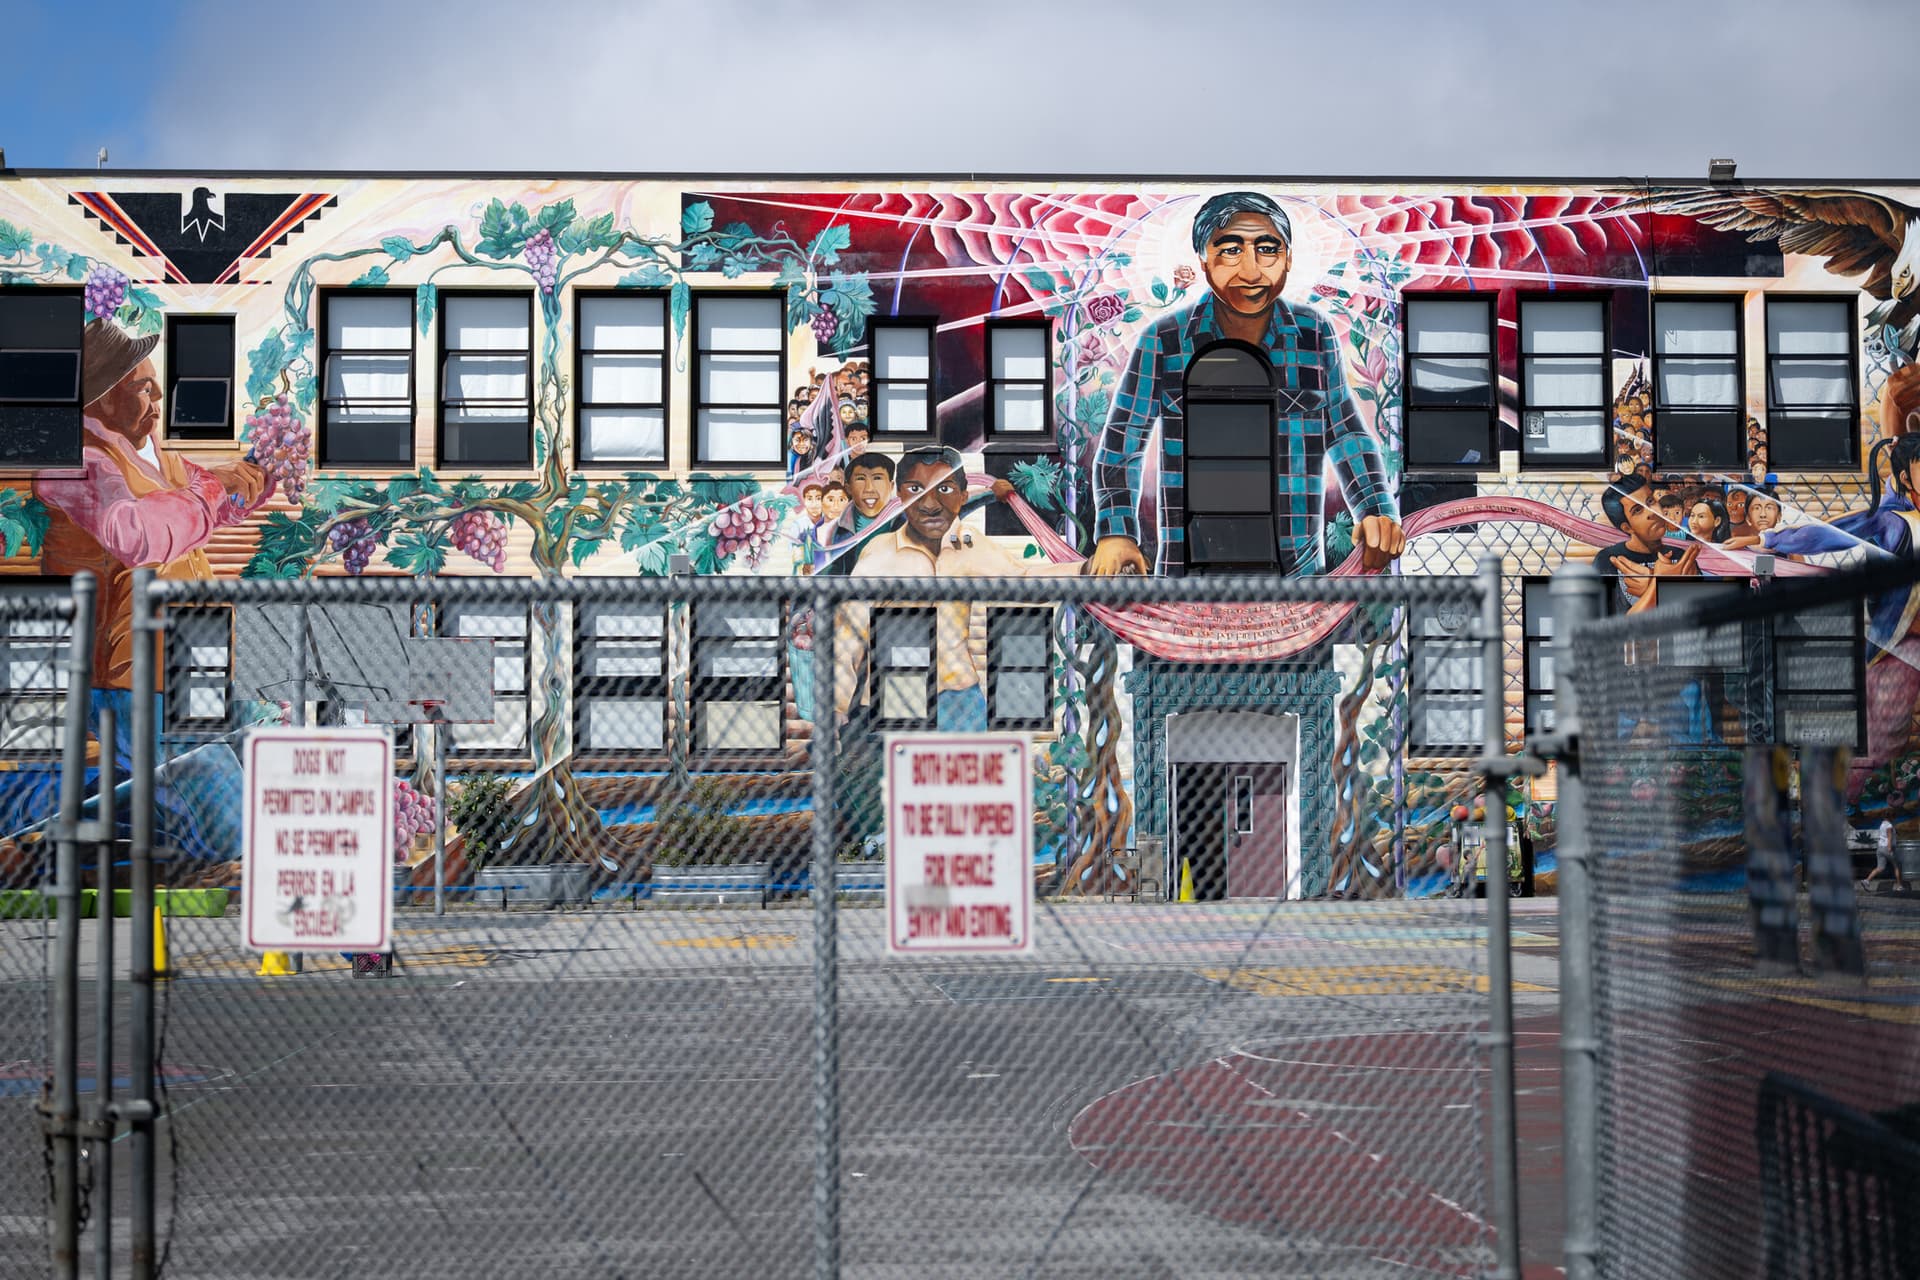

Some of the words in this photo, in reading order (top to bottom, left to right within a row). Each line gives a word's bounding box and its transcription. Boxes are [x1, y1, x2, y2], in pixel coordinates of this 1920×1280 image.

[293, 749, 321, 774] DOGS
[327, 749, 346, 774] NOT
[913, 754, 940, 784] BOTH
[946, 754, 978, 784] GATES
[983, 754, 1005, 784] ARE
[263, 790, 315, 815] PERMITTED
[320, 790, 330, 814] ON
[337, 790, 375, 815] CAMPUS
[903, 804, 915, 836] TO
[920, 804, 933, 836] BE
[938, 804, 968, 836] FULLY
[973, 804, 1014, 836] OPENED
[276, 830, 289, 856] NO
[293, 830, 304, 856] SE
[277, 870, 316, 896] PERROS
[322, 870, 333, 896] EN
[342, 871, 355, 896] LA
[925, 855, 945, 886] FOR
[951, 855, 994, 886] VEHICLE
[294, 910, 339, 936] ESCUELA
[909, 905, 940, 937] ENTRY
[946, 905, 966, 937] AND
[972, 905, 1011, 937] EXITING
